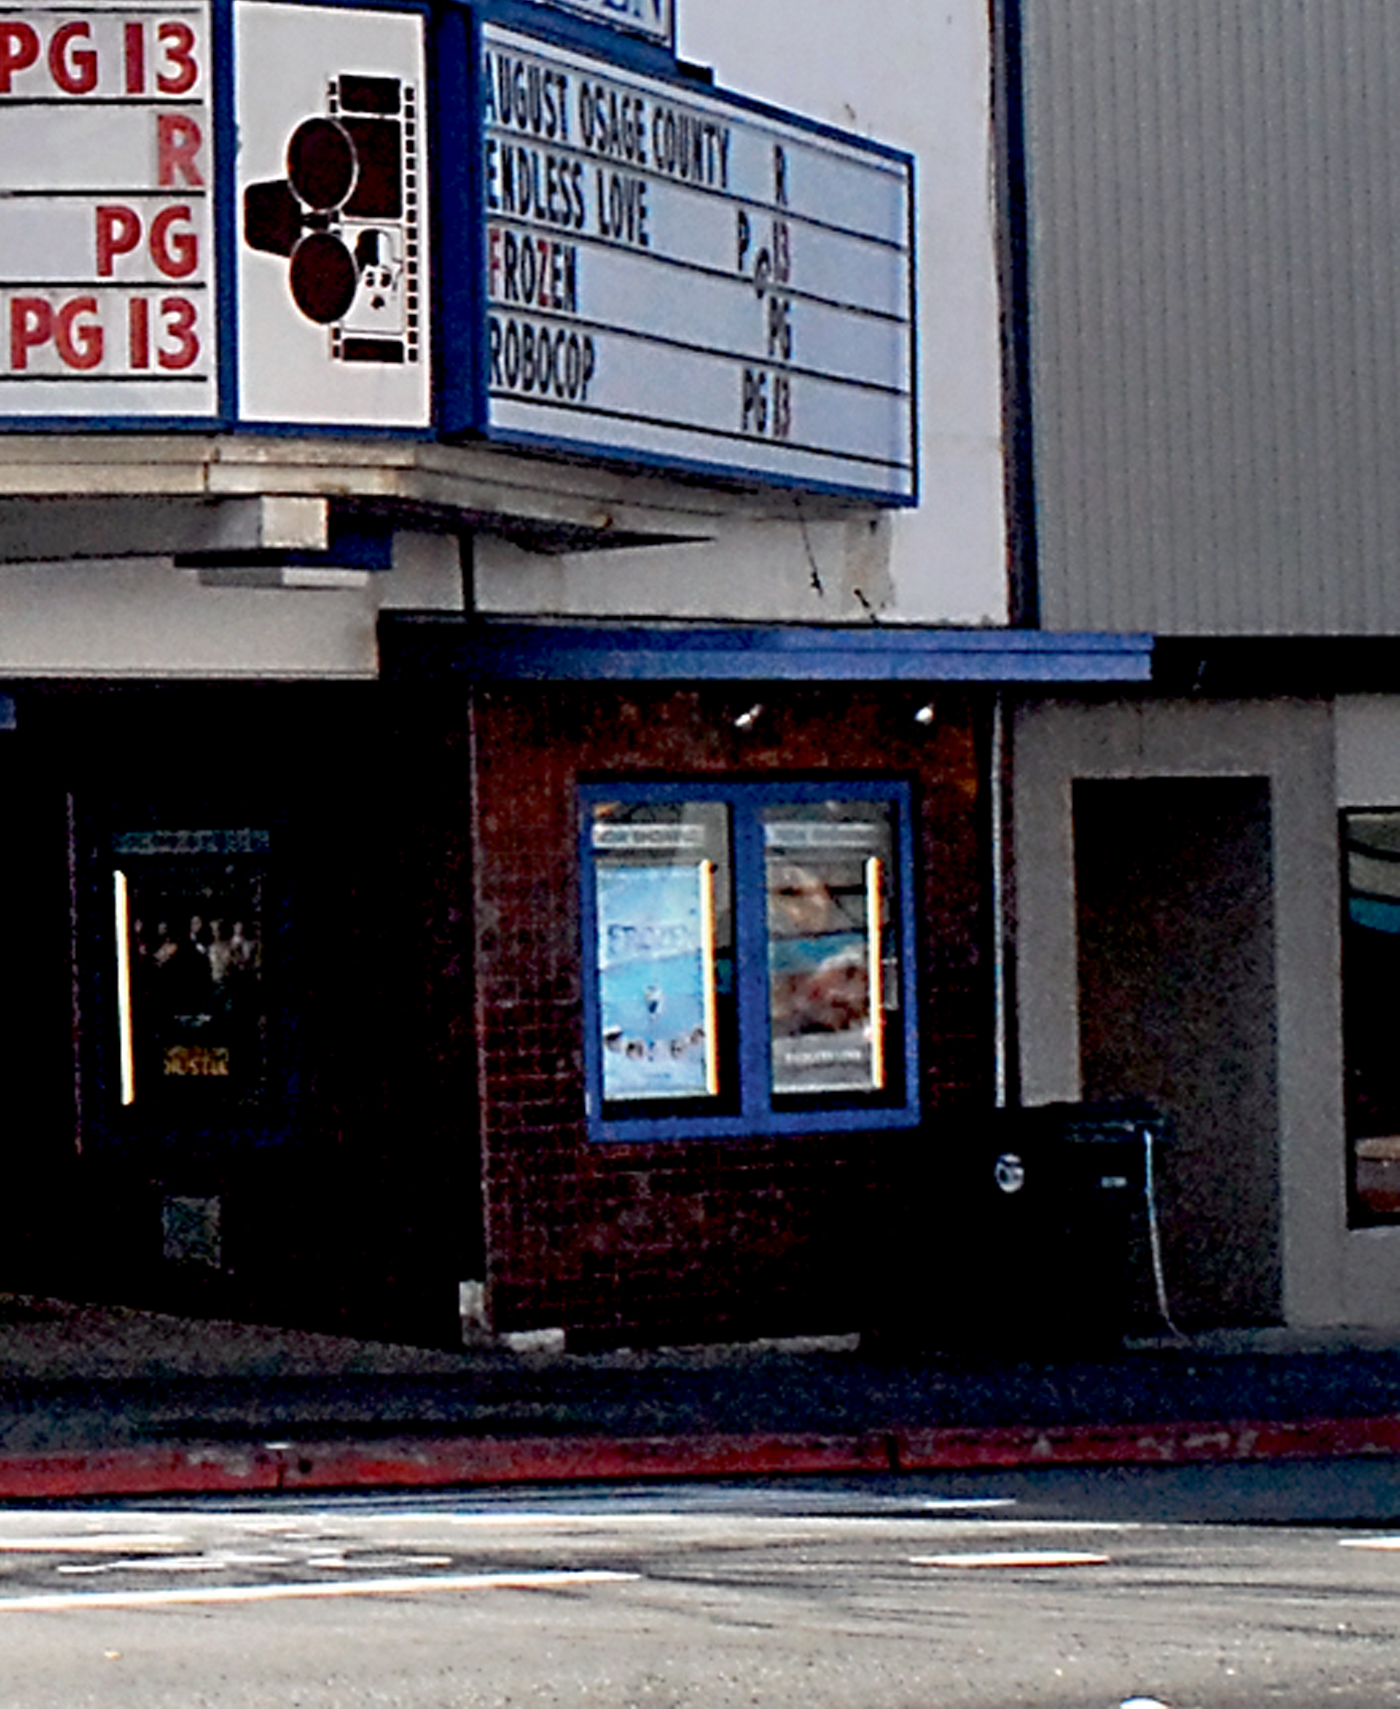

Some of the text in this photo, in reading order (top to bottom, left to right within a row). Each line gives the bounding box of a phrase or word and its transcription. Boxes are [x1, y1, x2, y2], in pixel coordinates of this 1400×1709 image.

[157, 114, 205, 187] R
[578, 81, 647, 165] OSAGE
[651, 106, 730, 189] COUNTY
[486, 139, 585, 230] ENDLESS
[596, 168, 649, 247] LOVE
[95, 204, 199, 278] PG
[488, 227, 578, 313] FROZEN
[488, 315, 596, 402] ROBOCOP
